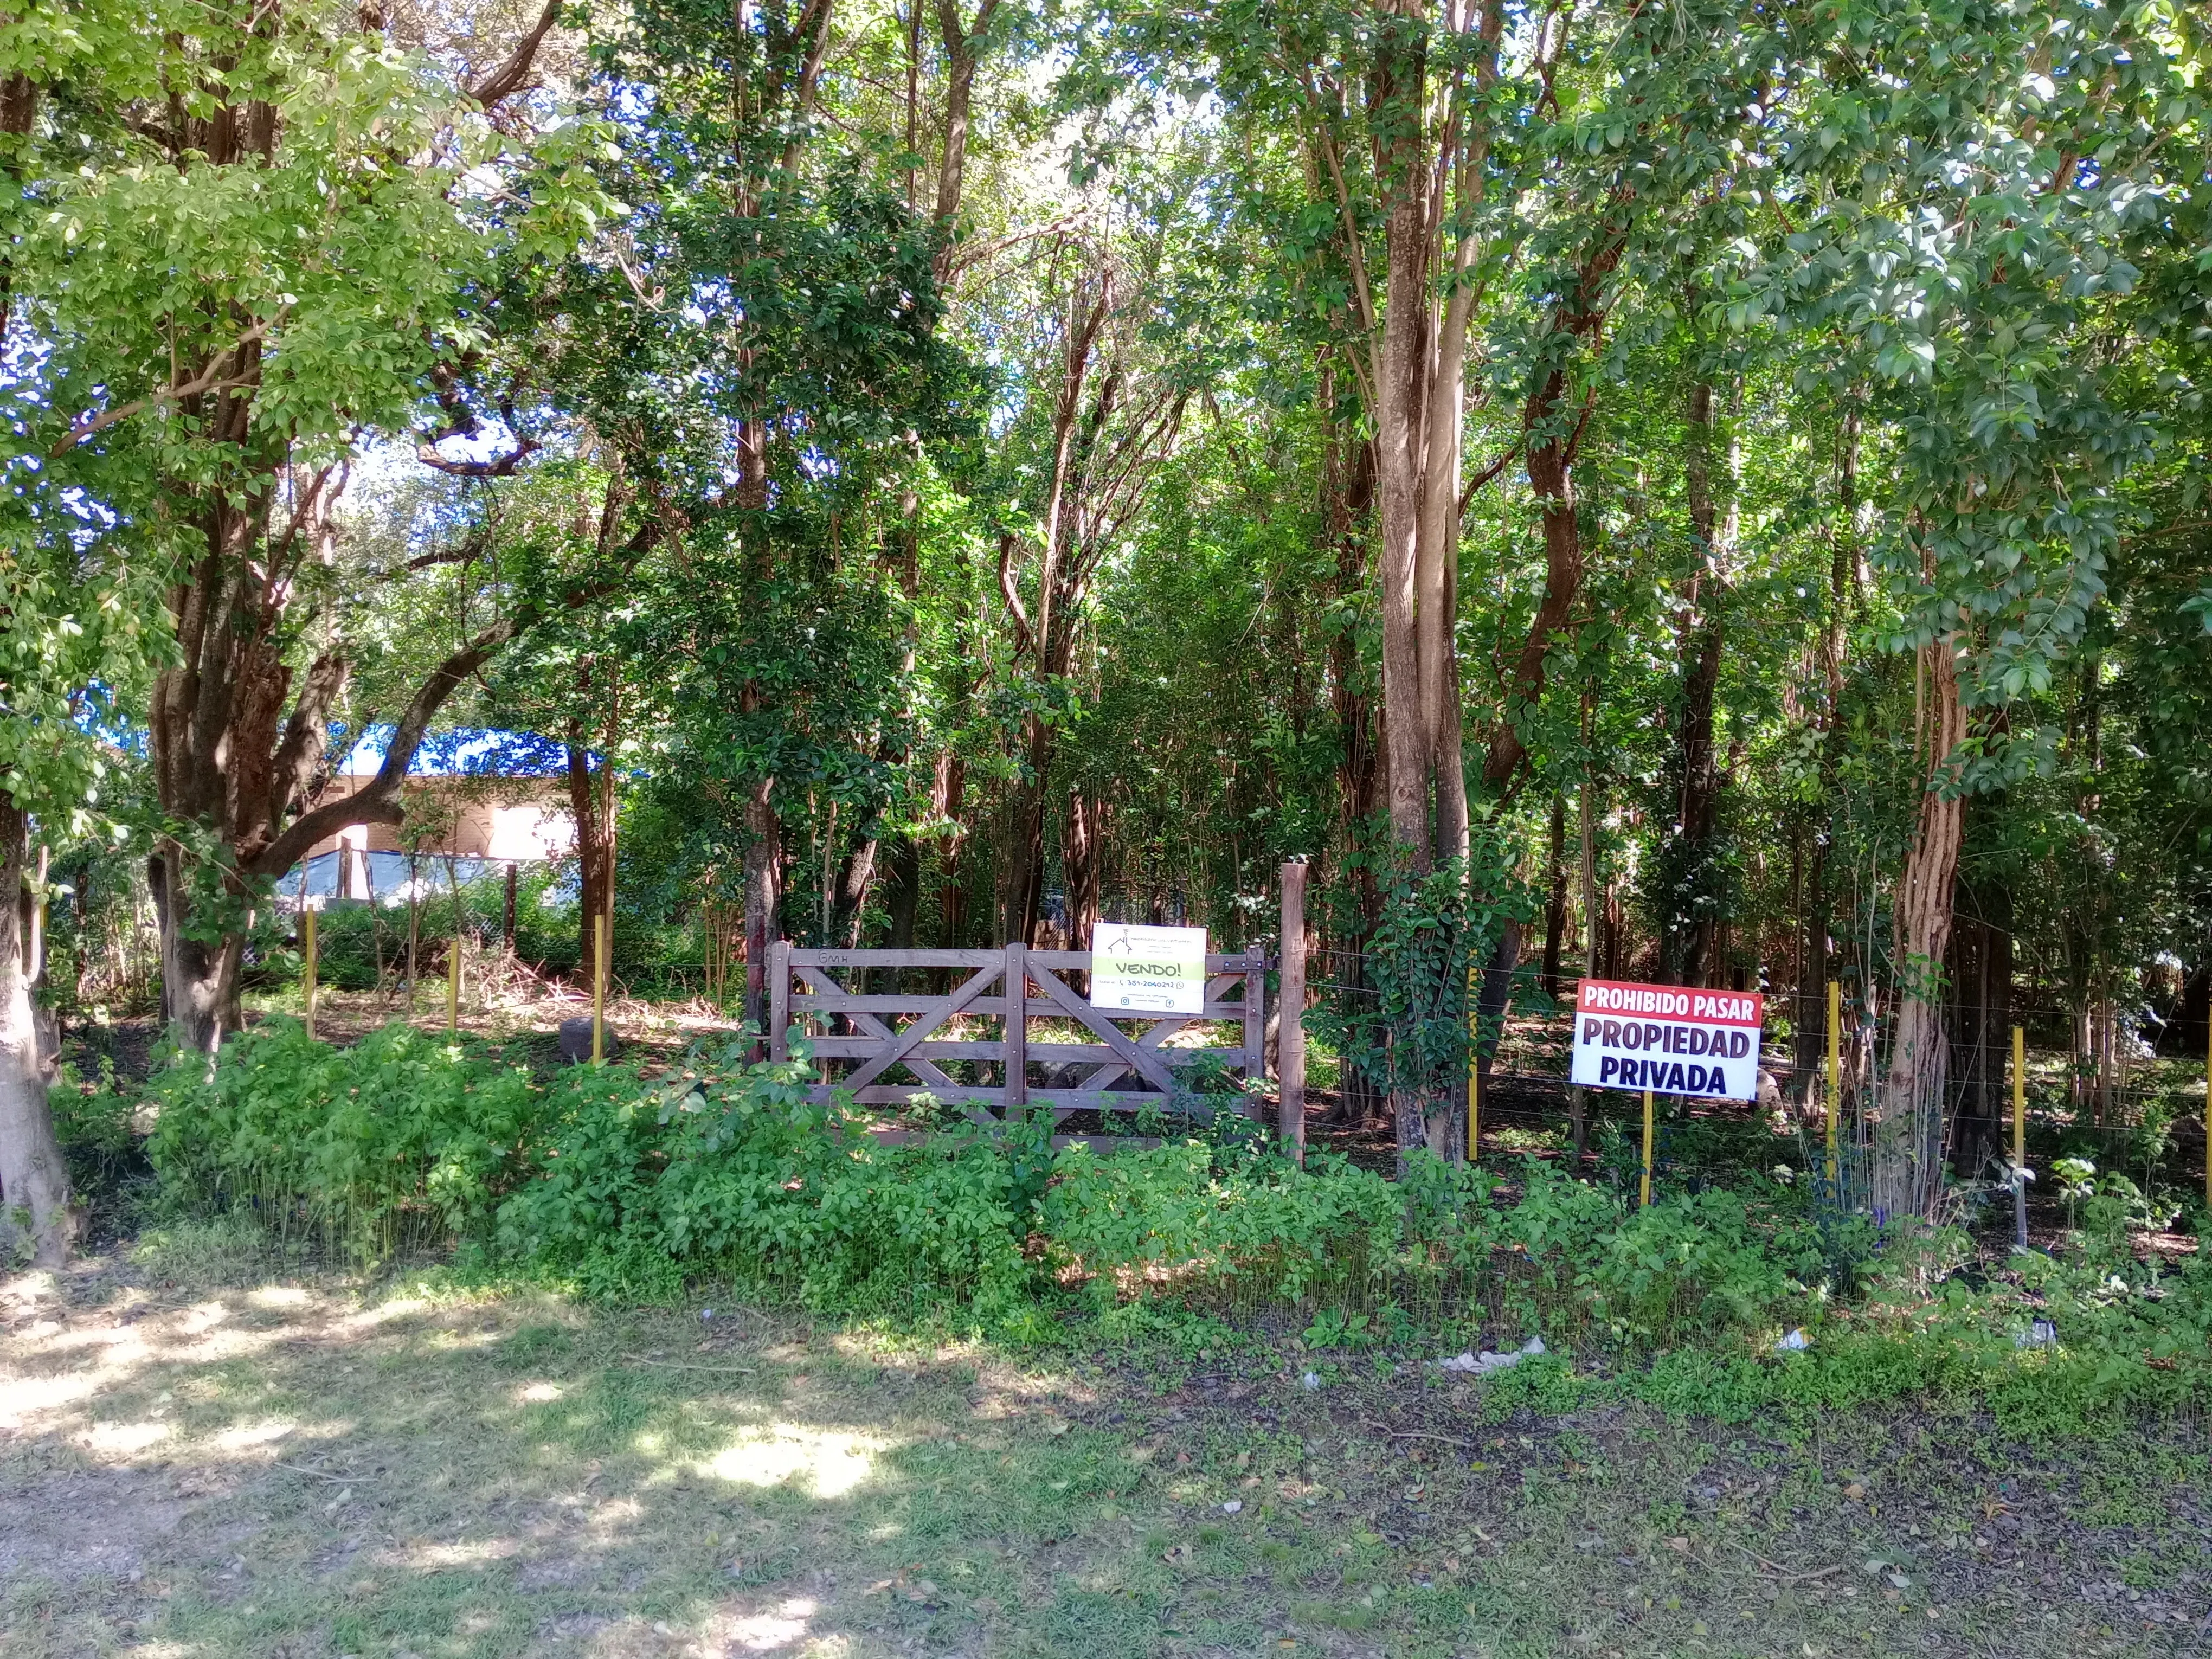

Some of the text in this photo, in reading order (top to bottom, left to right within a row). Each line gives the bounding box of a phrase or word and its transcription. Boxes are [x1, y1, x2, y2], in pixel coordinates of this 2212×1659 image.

[1116, 963, 1181, 977] VENDO!
[1127, 979, 1174, 988] 351-2040212
[1584, 986, 1754, 1021] PROHIBIDO PASAR
[1583, 1018, 1750, 1058] PROPIEDAD
[1600, 1056, 1727, 1094] PRIVADA
